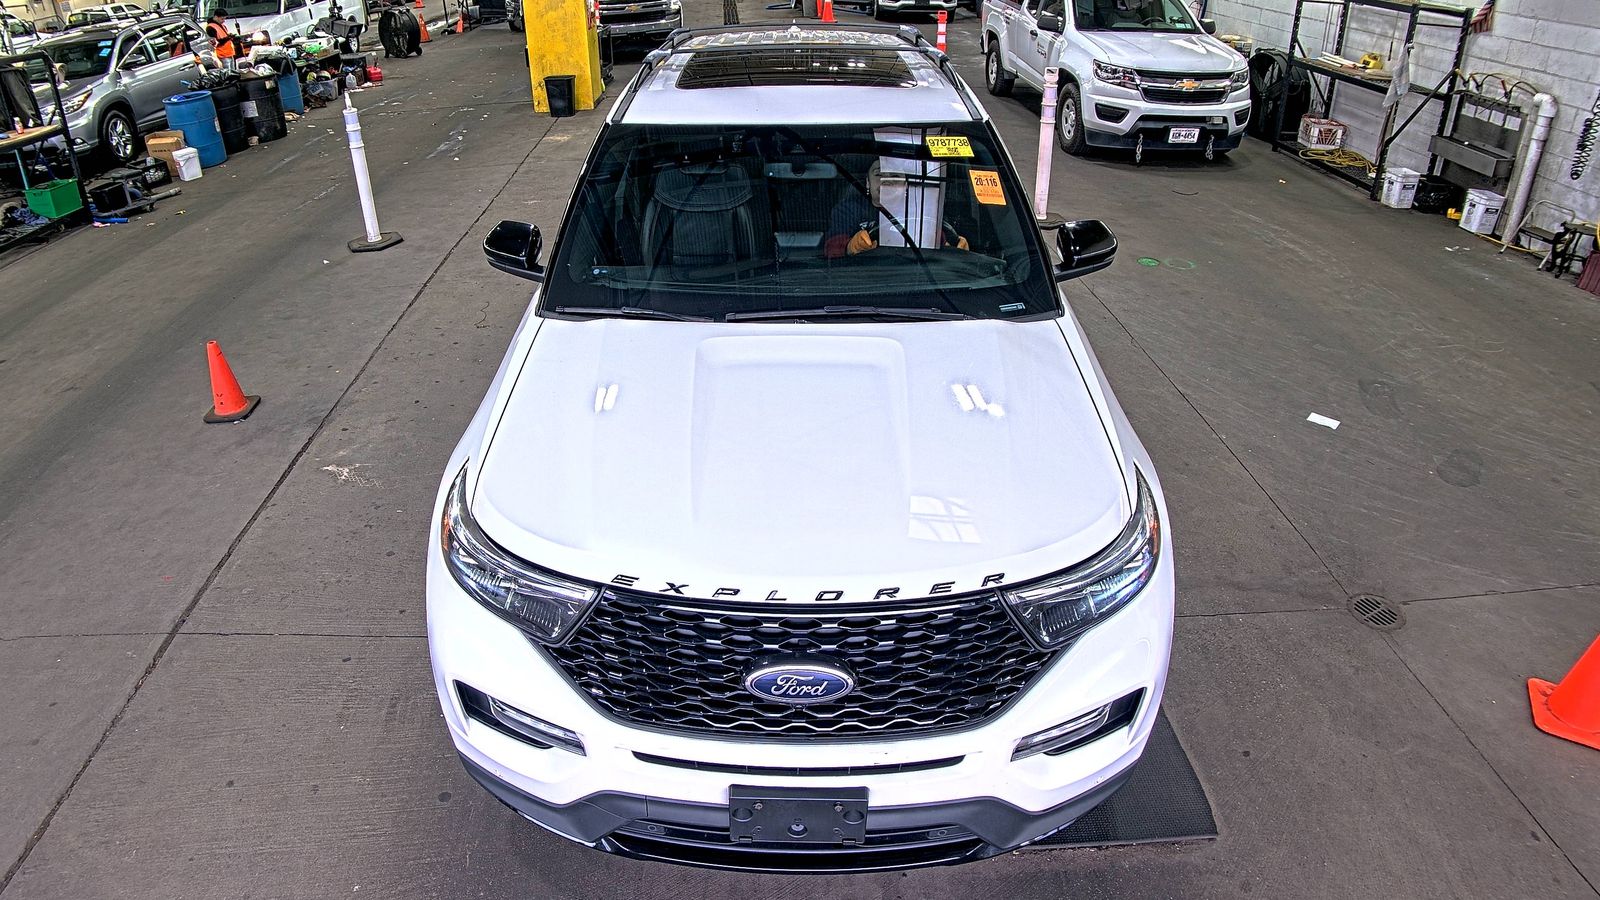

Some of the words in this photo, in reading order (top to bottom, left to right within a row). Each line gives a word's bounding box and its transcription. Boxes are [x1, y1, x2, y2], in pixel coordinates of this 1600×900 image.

[928, 138, 970, 147] 9787738
[974, 176, 998, 187] 20:116
[610, 572, 1006, 602] EXPLORER
[770, 674, 829, 696] Ford
